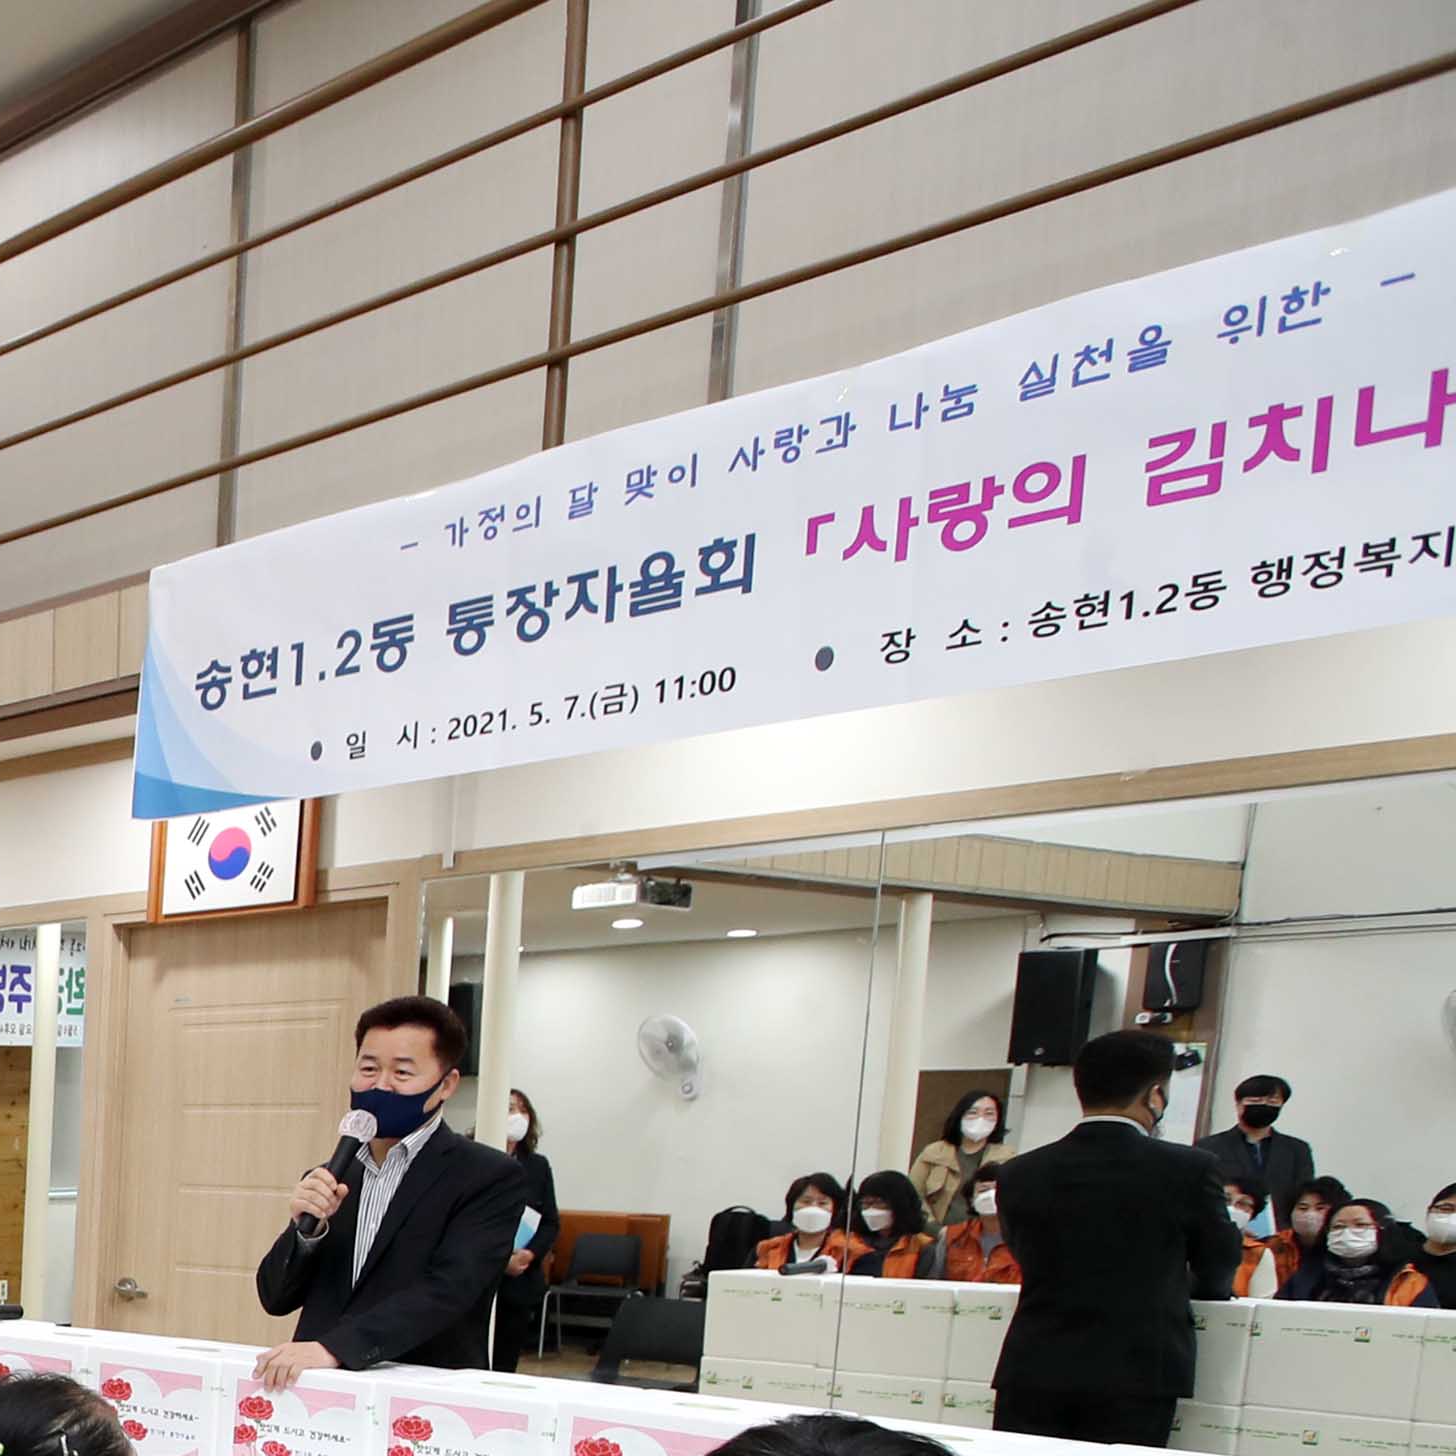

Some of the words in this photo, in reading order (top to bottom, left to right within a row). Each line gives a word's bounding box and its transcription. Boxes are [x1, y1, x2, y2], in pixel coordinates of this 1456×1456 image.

[444, 495, 543, 550] 가정의
[566, 481, 599, 521] 달
[623, 453, 699, 506] 맞이
[728, 412, 857, 473] 사랑과
[887, 382, 978, 431] 나눔
[1017, 324, 1173, 401] 실천을
[1216, 280, 1331, 345] 위한
[194, 612, 416, 712] 송현1.2동
[445, 532, 758, 658] 통장자율회
[1144, 367, 1456, 508] 김치나
[879, 627, 917, 665] 장
[944, 618, 984, 651] 소
[1026, 569, 1228, 638] 송현1.2동
[1250, 525, 1456, 599] 행정복지
[344, 730, 368, 762] 일
[395, 719, 420, 751] 시
[446, 709, 518, 743] 2021.
[528, 701, 551, 728] 5.
[563, 681, 641, 724] 7.(금)
[654, 665, 737, 706] 11:00
